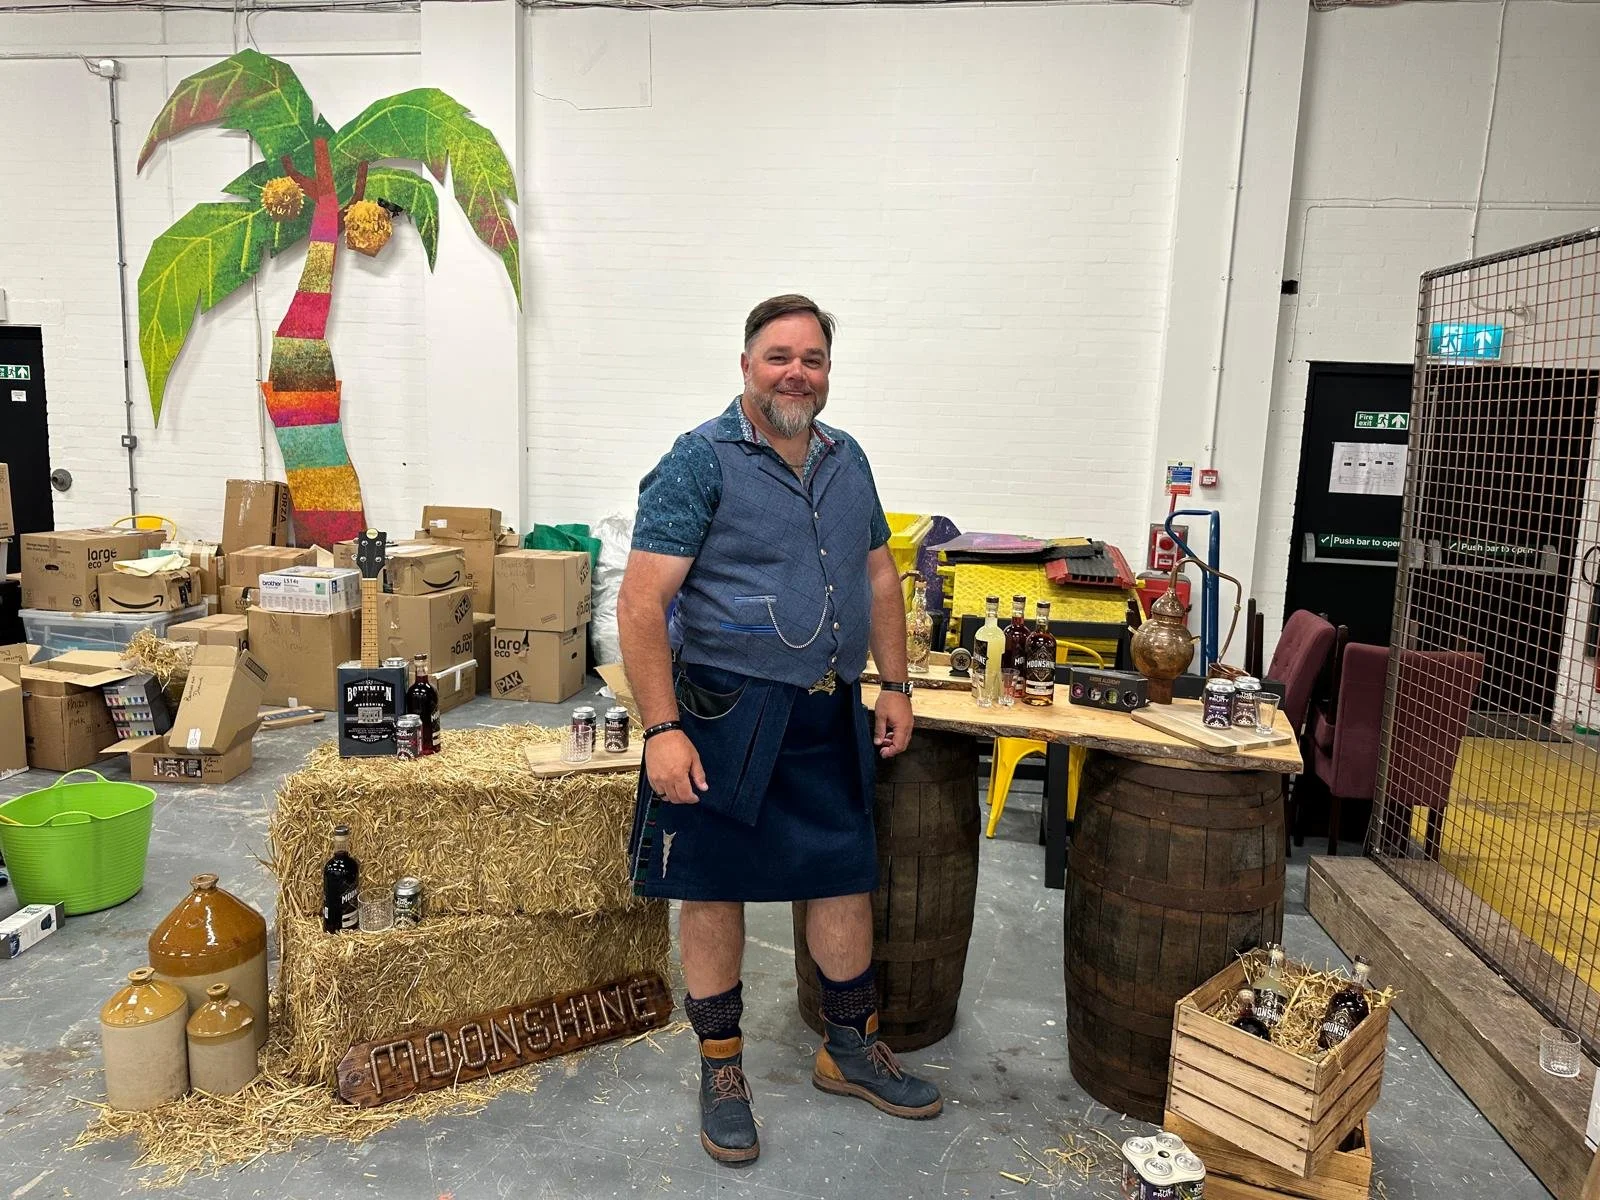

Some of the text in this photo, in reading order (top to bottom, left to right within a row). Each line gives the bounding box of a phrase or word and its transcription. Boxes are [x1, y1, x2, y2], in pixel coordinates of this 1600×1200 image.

[1333, 536, 1355, 545] Push
[1356, 538, 1370, 546] bar
[1371, 538, 1381, 546] to
[1461, 543, 1483, 551] Push
[1500, 545, 1510, 553] to
[87, 547, 117, 563] large
[87, 561, 102, 569] eco
[262, 580, 282, 588] brother
[451, 640, 473, 655] large
[494, 650, 511, 658] eco
[500, 672, 523, 692] PAK
[347, 685, 392, 702] BOHEMIAN
[369, 978, 657, 1096] MOONSHINE
